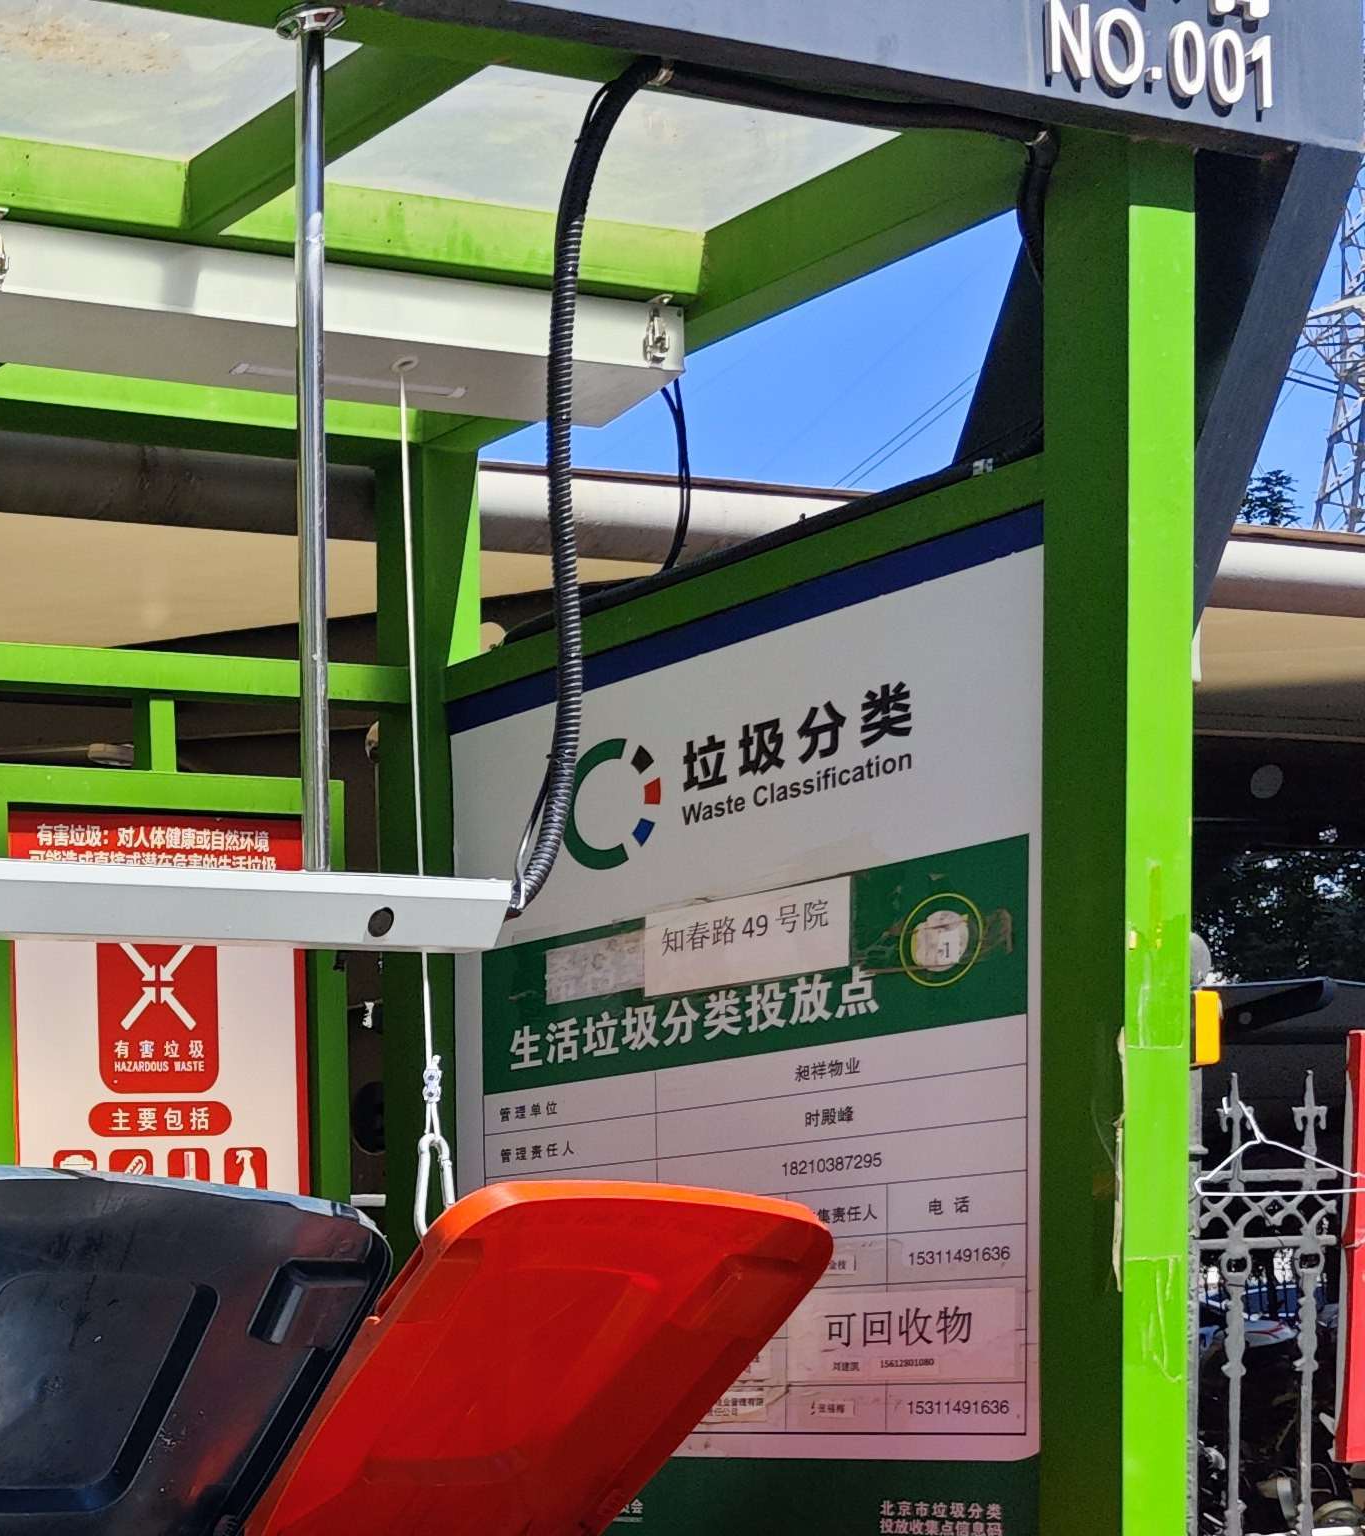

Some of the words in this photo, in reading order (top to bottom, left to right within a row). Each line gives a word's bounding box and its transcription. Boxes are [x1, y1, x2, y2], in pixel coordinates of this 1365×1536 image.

[1045, 0, 1273, 110] NO.001
[683, 681, 913, 792] 垃圾分类
[681, 795, 746, 826] Waste
[752, 749, 913, 808] Classification
[36, 823, 270, 853] 有害垃圾：对人体健康或自然环境
[509, 966, 880, 1072] 生活垃圾分类投放点
[114, 1040, 205, 1059] 有害垃圾
[114, 1061, 169, 1072] HAZARDOUS
[174, 1061, 205, 1072] WASTE
[111, 1107, 210, 1131] 主要包括
[499, 1101, 558, 1122] 管理单位
[500, 1141, 574, 1163] 管理责任人
[782, 1152, 882, 1176] 18210387295
[813, 1204, 878, 1224] 集责任人
[928, 1196, 970, 1215] 电话
[909, 1246, 1010, 1266] 15311491636
[825, 1306, 972, 1347] 可回收物
[907, 1400, 1009, 1416] 15311491636
[880, 1500, 1002, 1520] 北京市垃圾分类
